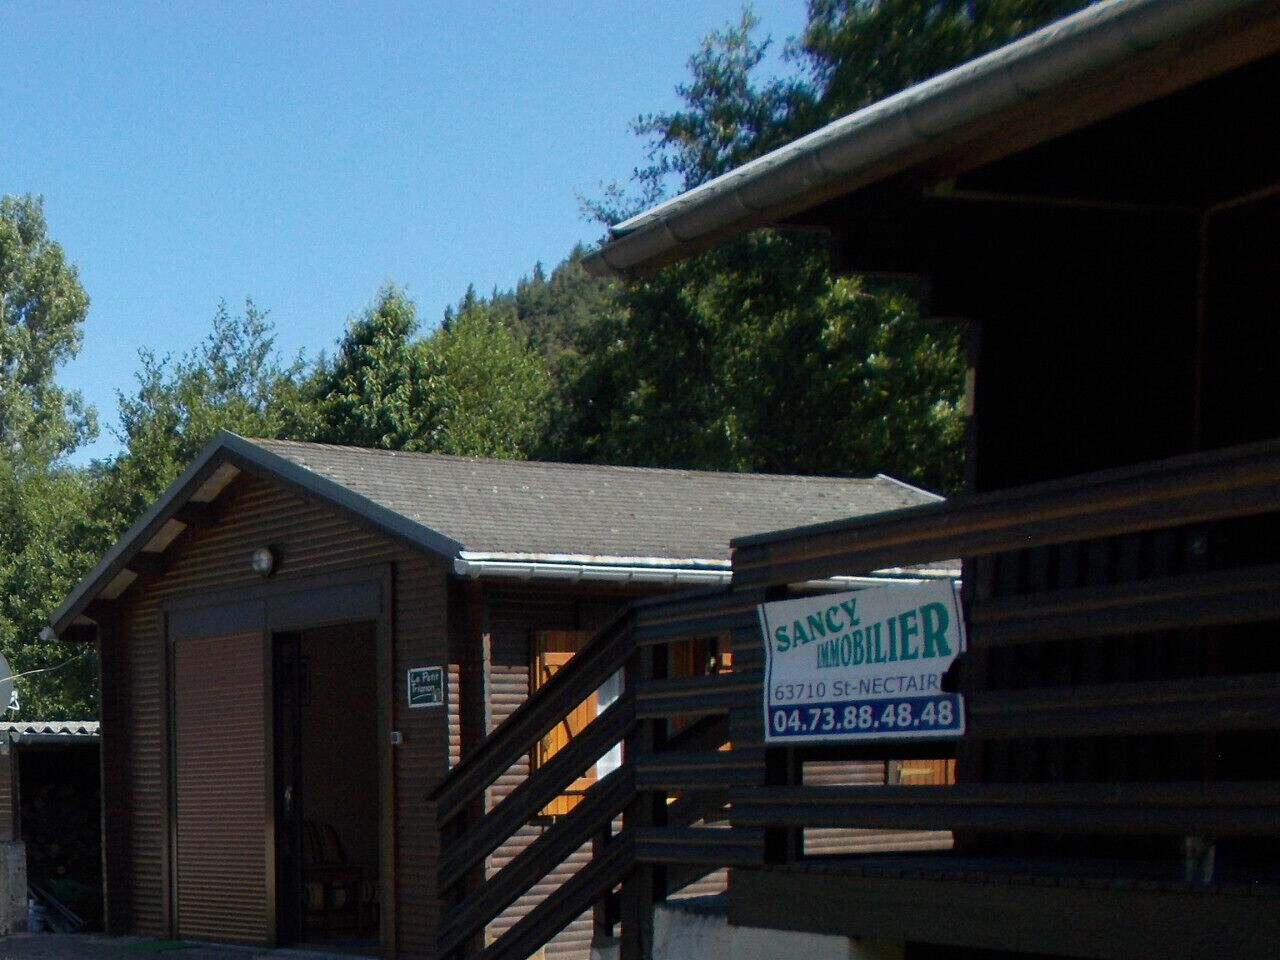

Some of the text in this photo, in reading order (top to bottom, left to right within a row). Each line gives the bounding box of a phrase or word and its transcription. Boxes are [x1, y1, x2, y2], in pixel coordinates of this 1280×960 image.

[775, 598, 860, 652] SANCY
[816, 602, 952, 669] IMMOBILIER
[775, 674, 939, 701] 63710 St-NECTAIR
[773, 700, 954, 732] 04.73.88.48.48
